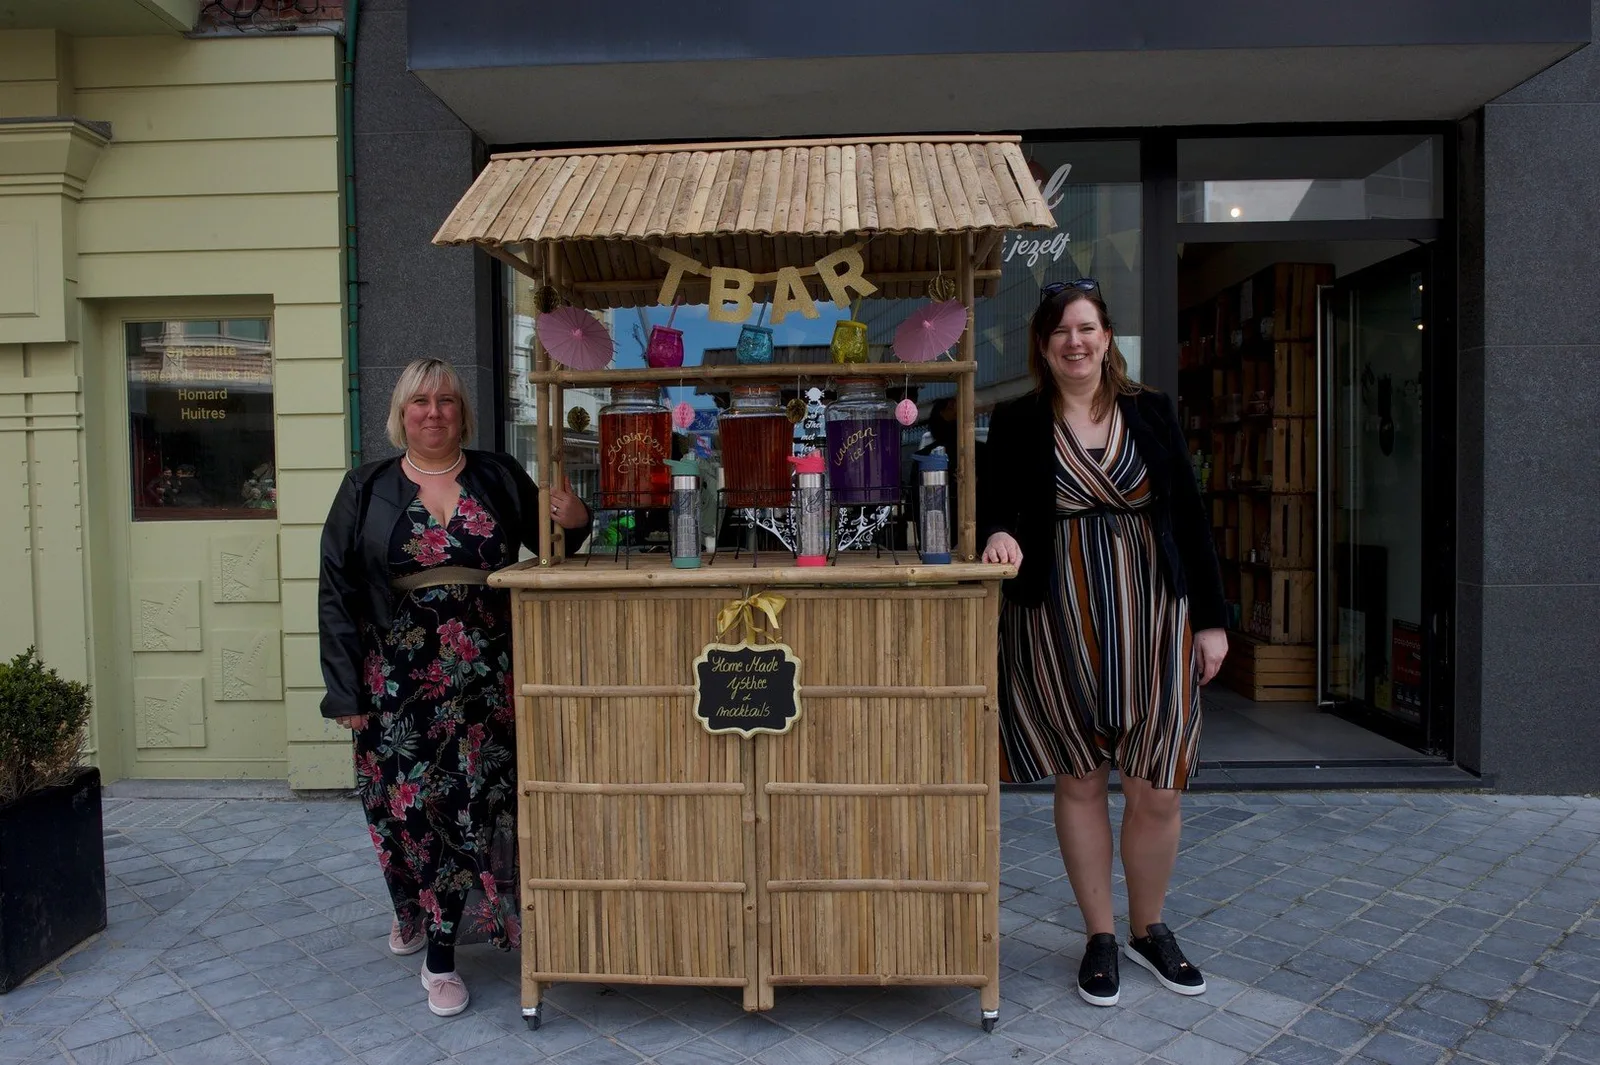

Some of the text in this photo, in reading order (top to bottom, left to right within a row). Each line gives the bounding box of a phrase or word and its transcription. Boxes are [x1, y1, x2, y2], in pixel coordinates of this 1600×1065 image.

[1004, 233, 1071, 267] jezelf
[228, 369, 240, 380] de
[178, 388, 228, 400] Homard
[181, 407, 226, 420] Huitres
[711, 656, 779, 672] Home Made
[715, 702, 772, 718] mocktails
